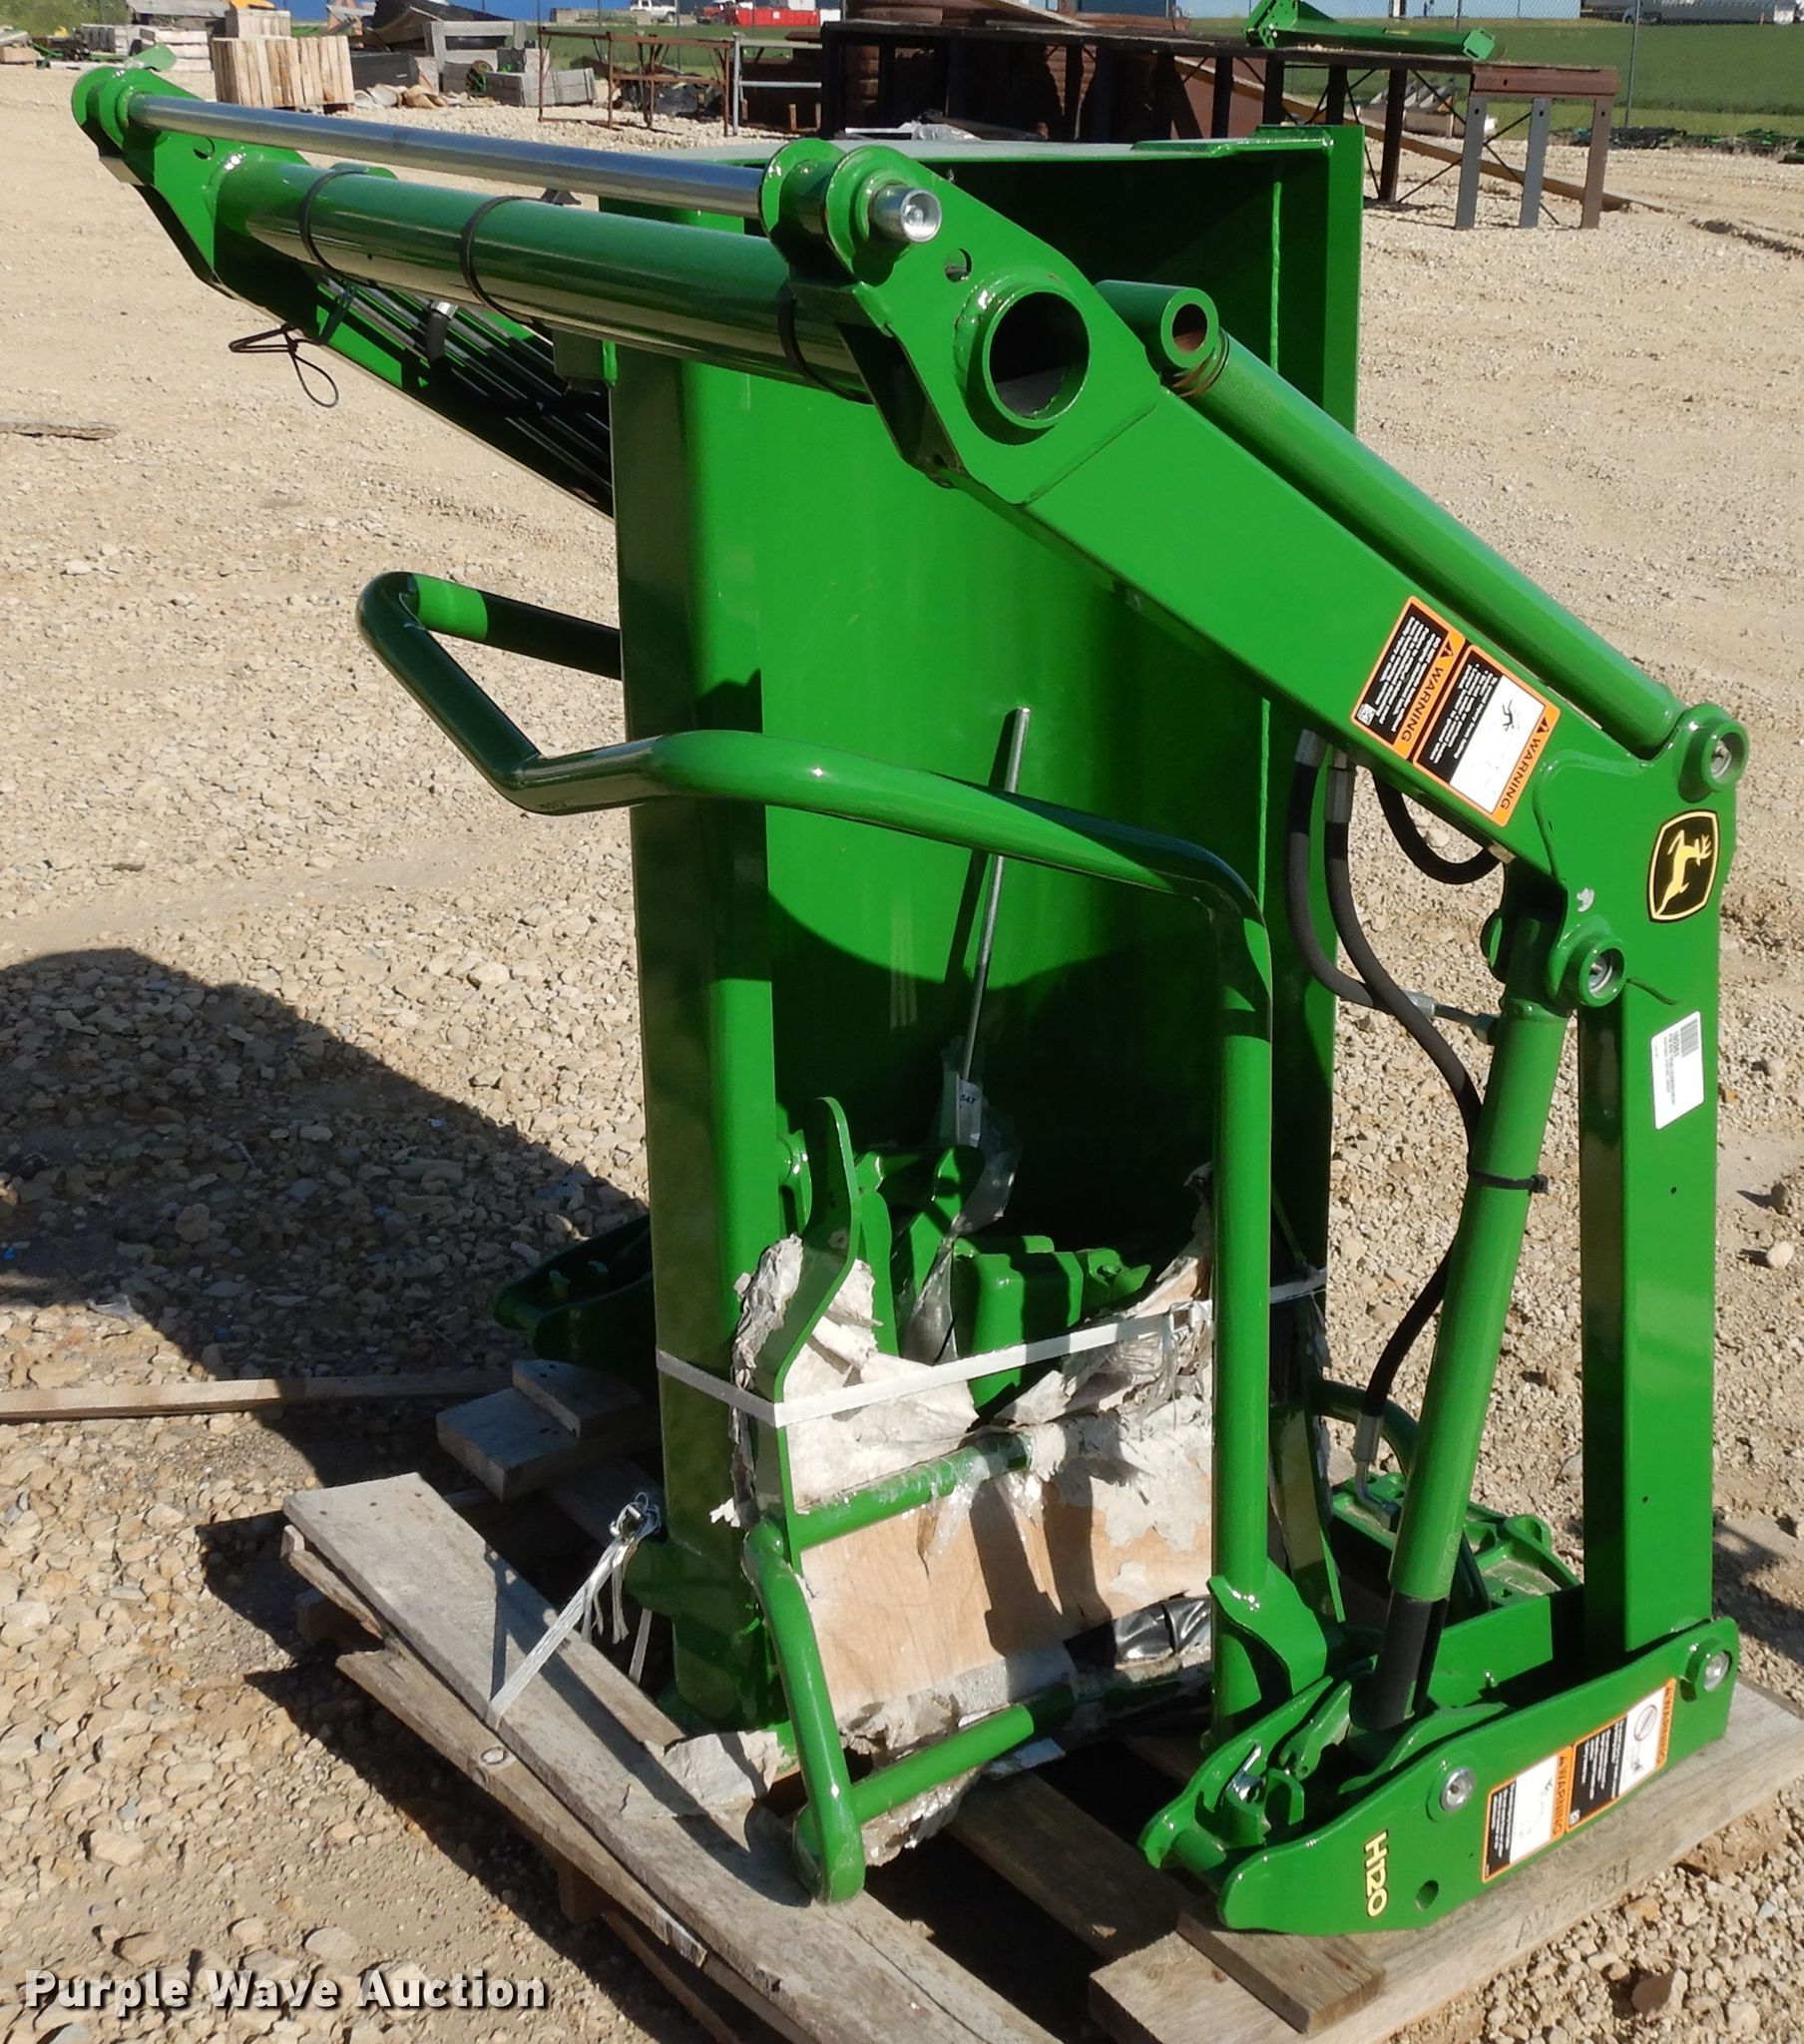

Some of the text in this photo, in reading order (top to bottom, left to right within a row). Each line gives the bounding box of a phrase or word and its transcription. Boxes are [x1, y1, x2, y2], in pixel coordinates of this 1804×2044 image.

[1400, 666, 1445, 743] WARNING
[1500, 736, 1543, 810] WARNING
[1552, 1765, 1565, 1835] WARNING
[1364, 1828, 1389, 1917] H120
